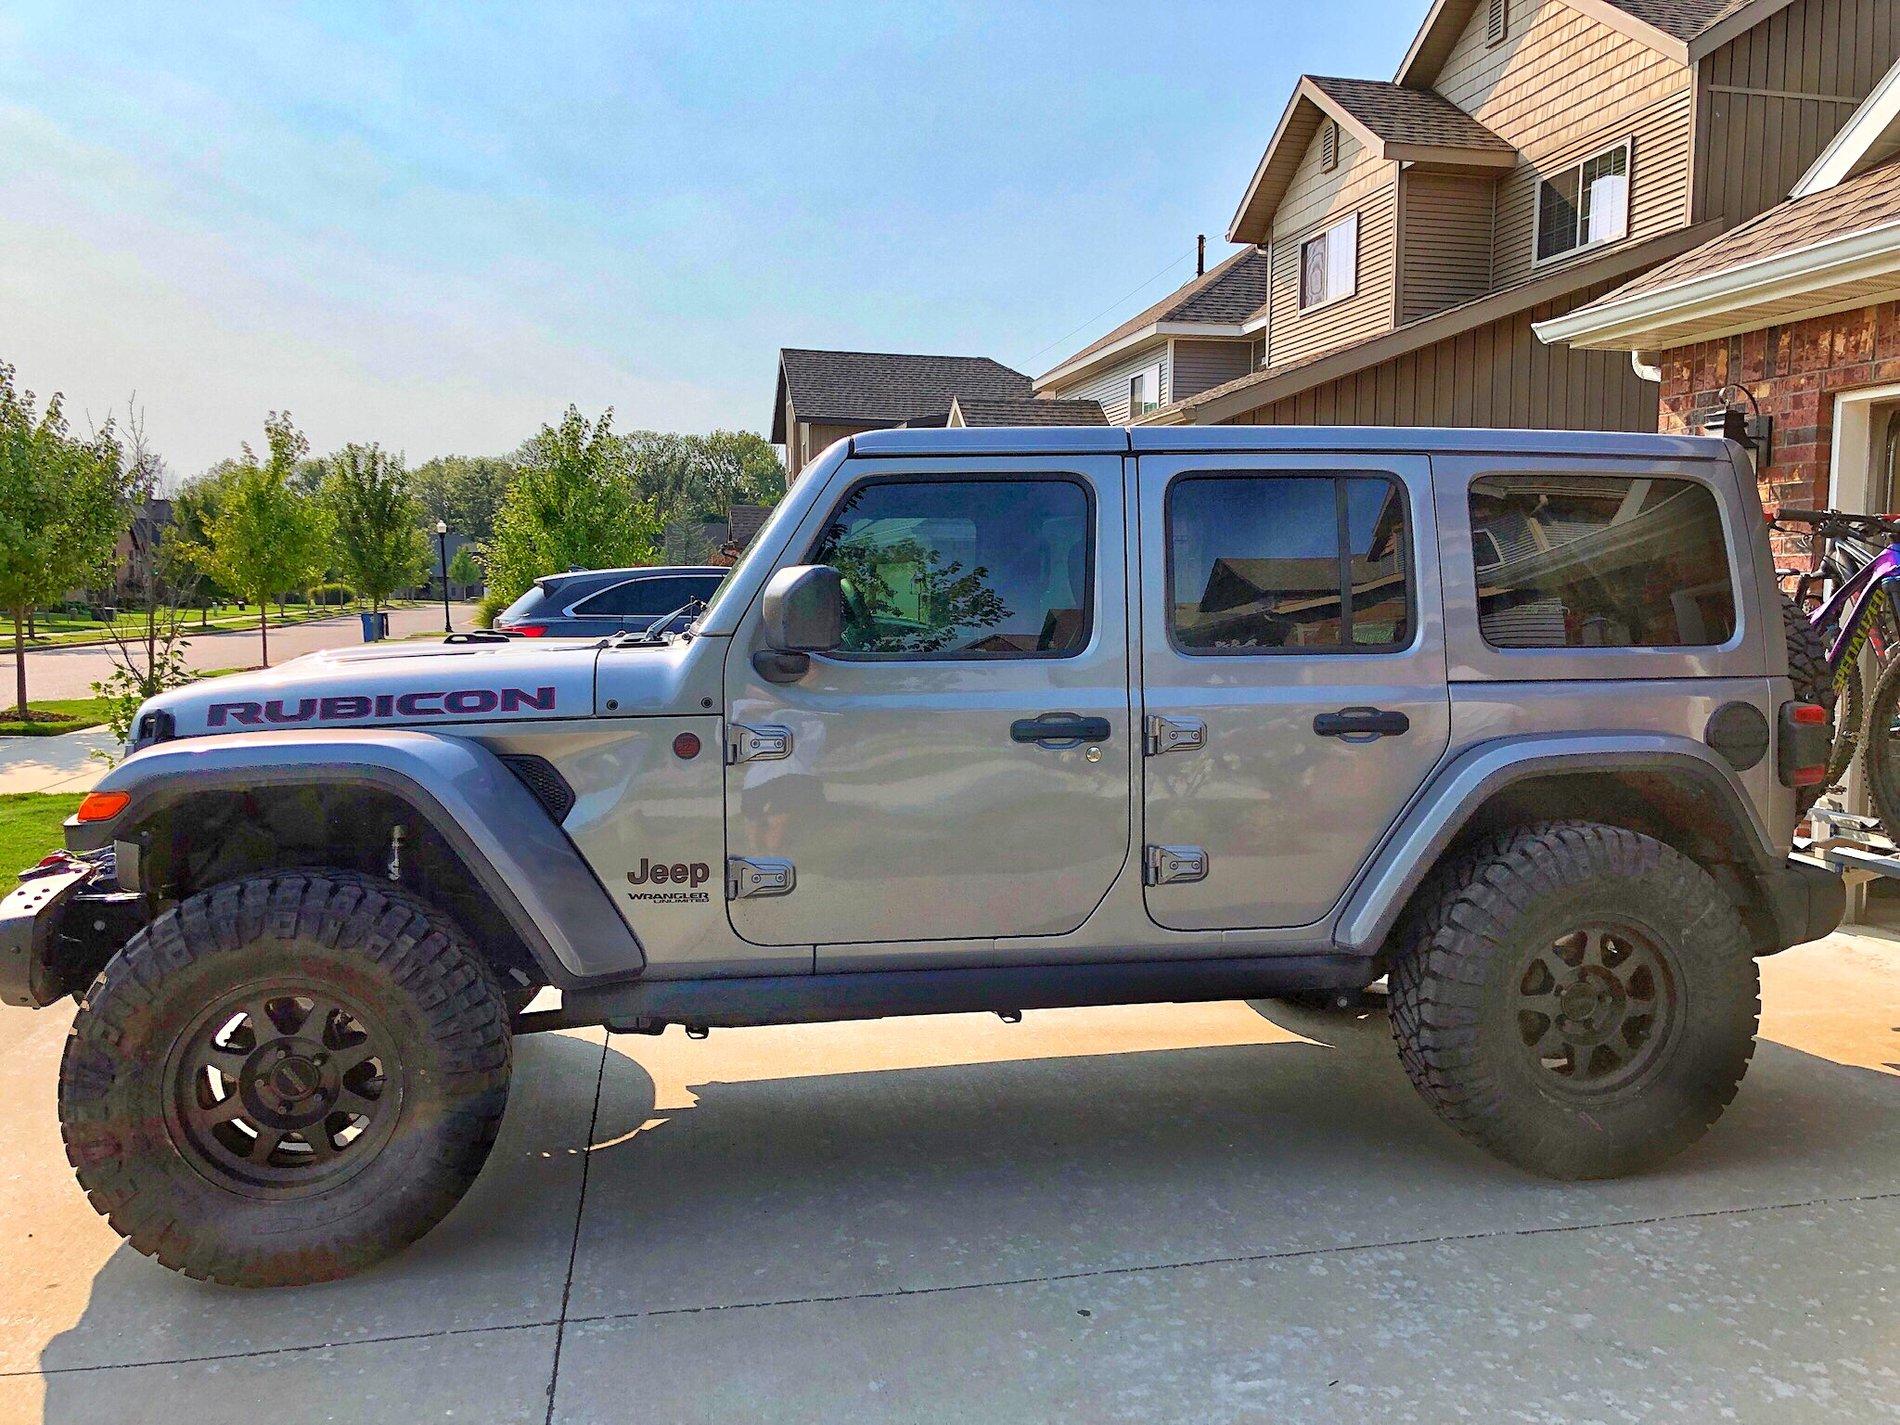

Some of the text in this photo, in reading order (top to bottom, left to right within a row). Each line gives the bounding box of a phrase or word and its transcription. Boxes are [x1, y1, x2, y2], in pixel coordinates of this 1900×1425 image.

[207, 686, 556, 727] RUBICON
[627, 858, 710, 888] Jeep
[628, 892, 709, 900] WRANGLER
